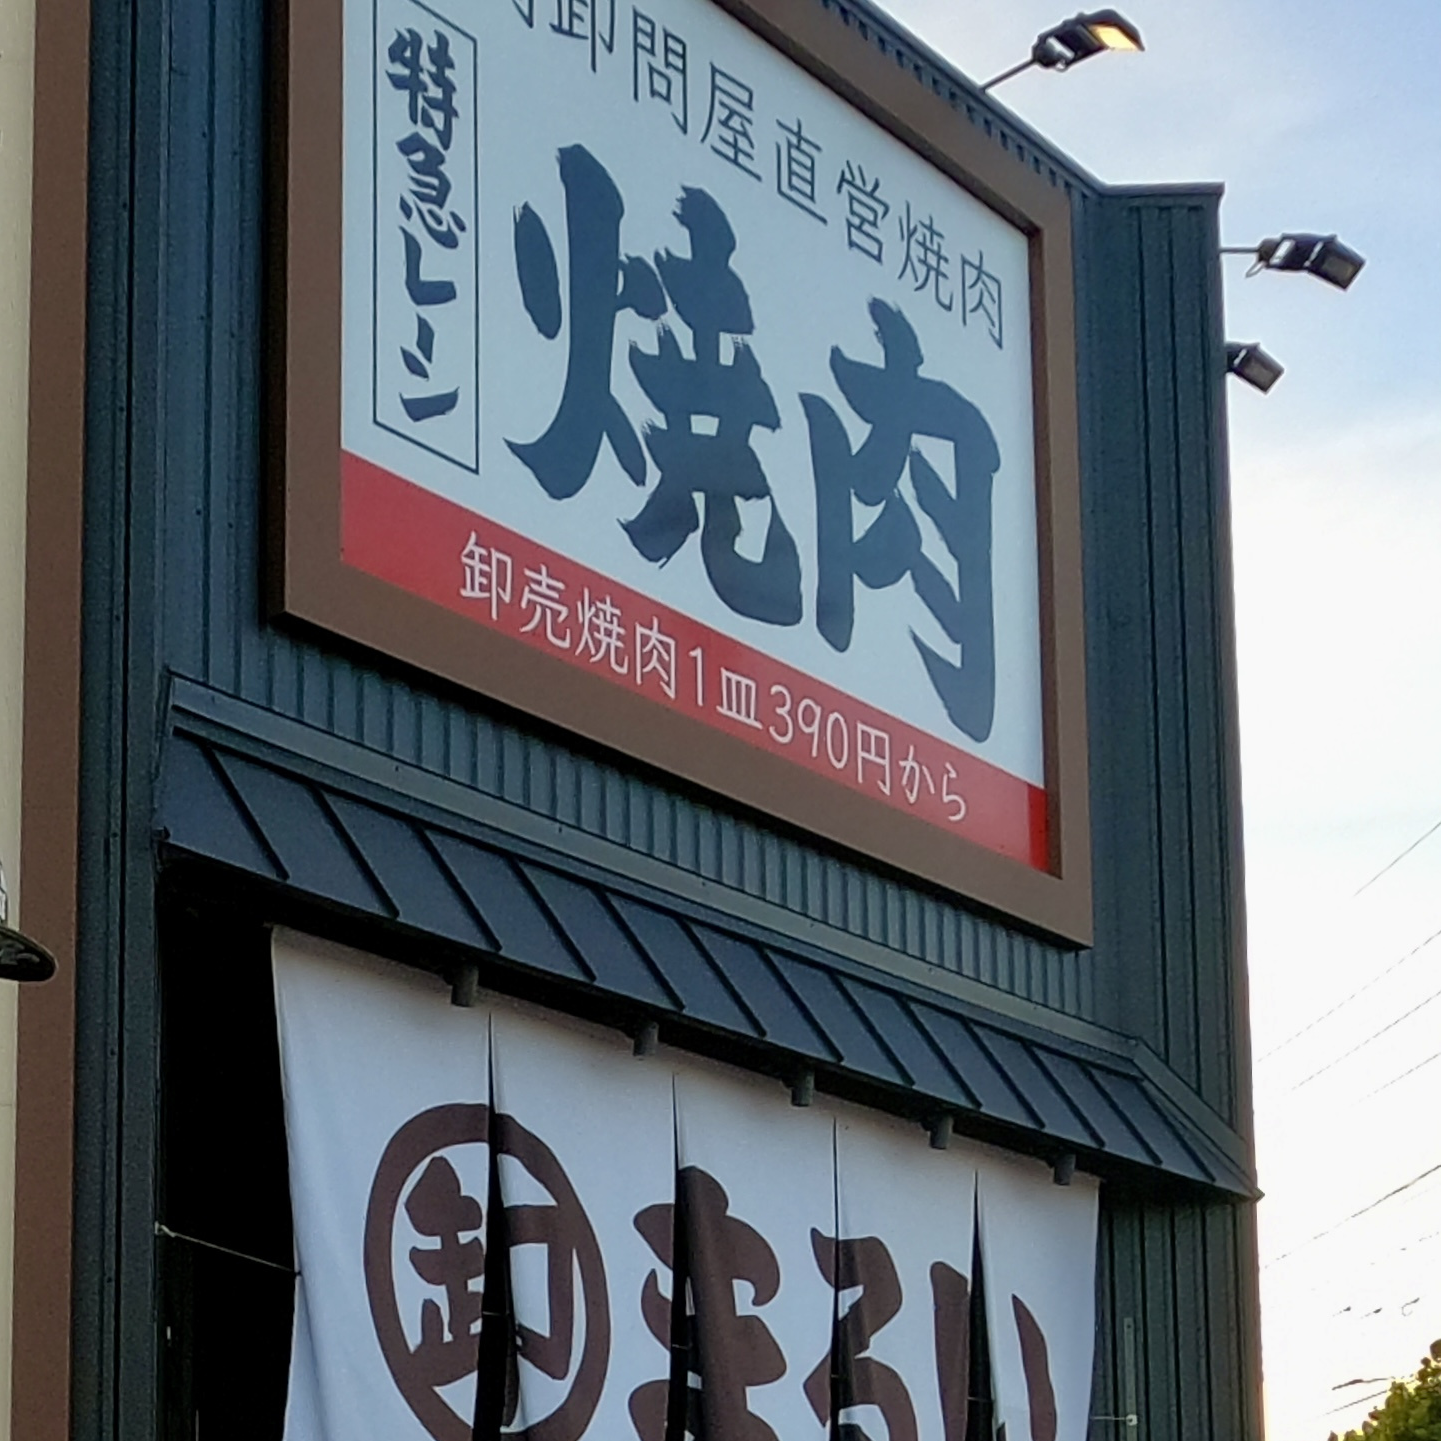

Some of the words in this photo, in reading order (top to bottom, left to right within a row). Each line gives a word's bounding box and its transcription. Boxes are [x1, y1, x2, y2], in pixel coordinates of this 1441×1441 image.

[385, 26, 467, 423] 特急レーン
[513, 0, 1004, 350] 卸問屋直営焼肉
[502, 142, 1001, 744] 焼肉
[459, 530, 968, 822] 卸売焼肉1皿390円から
